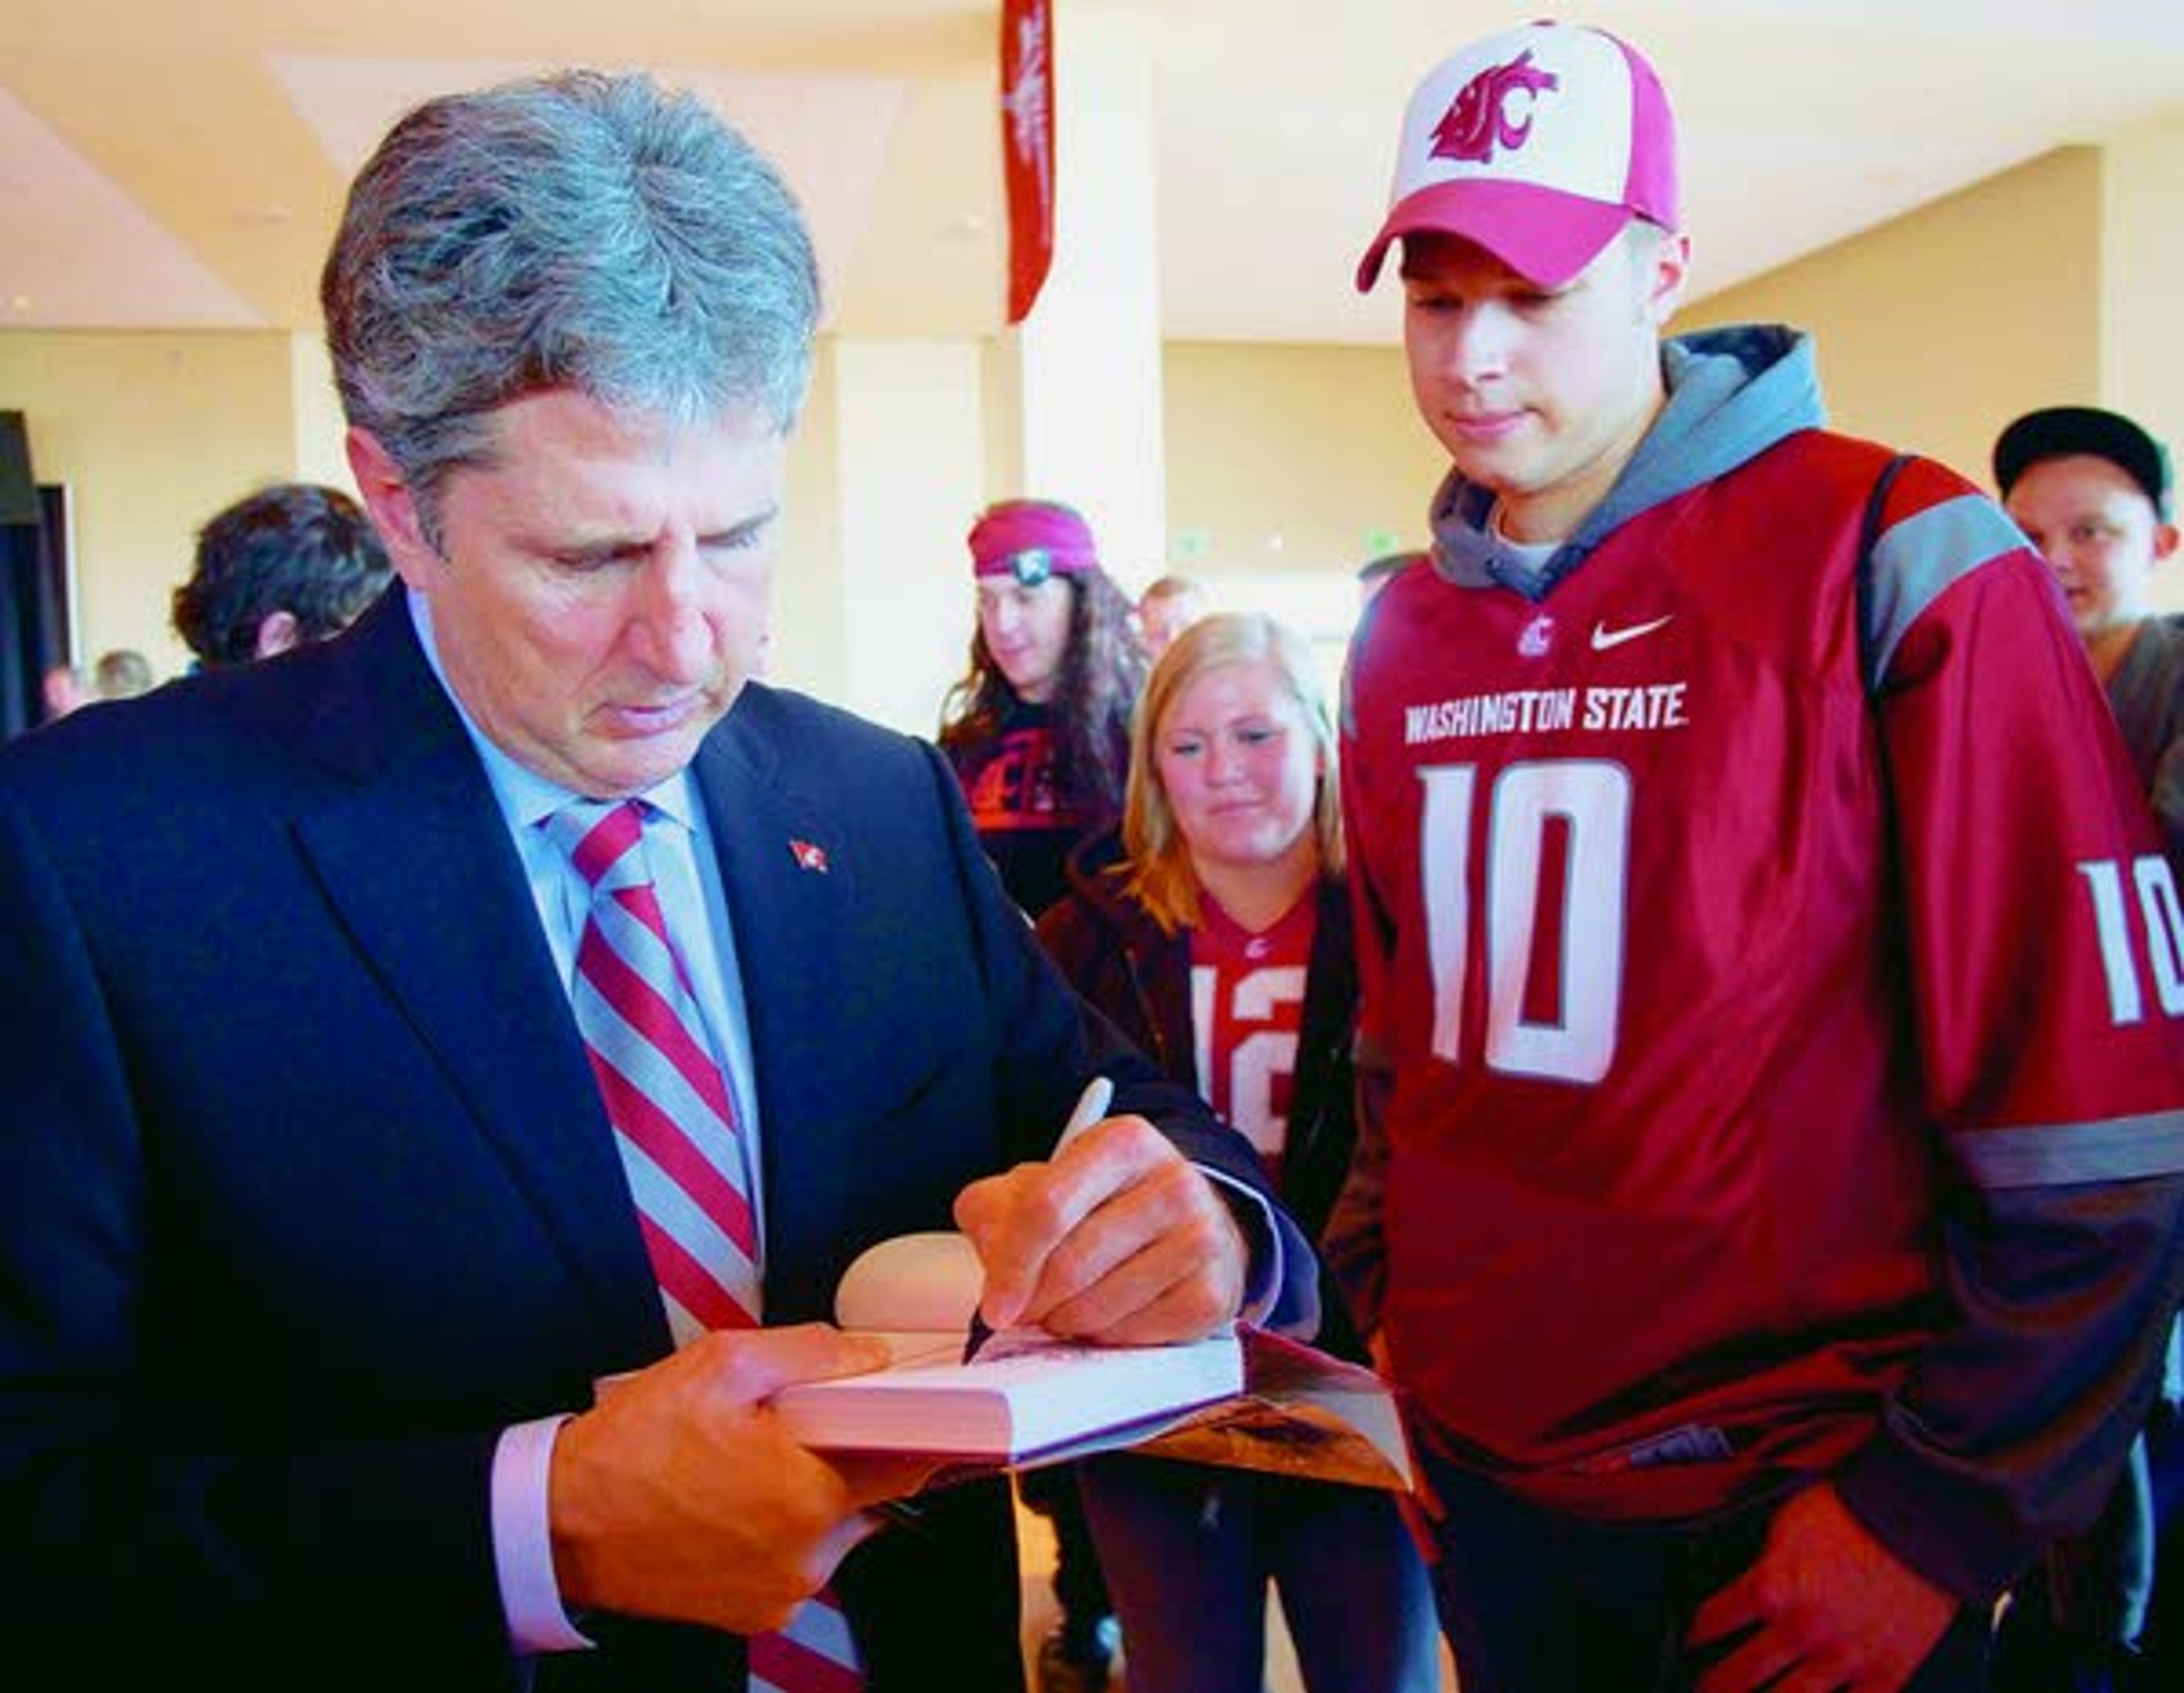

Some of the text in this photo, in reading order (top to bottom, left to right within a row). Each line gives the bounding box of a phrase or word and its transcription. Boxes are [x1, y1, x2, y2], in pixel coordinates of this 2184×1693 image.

[1405, 683, 1687, 744] WASHINGTON STATE
[1414, 758, 1633, 1085] 10
